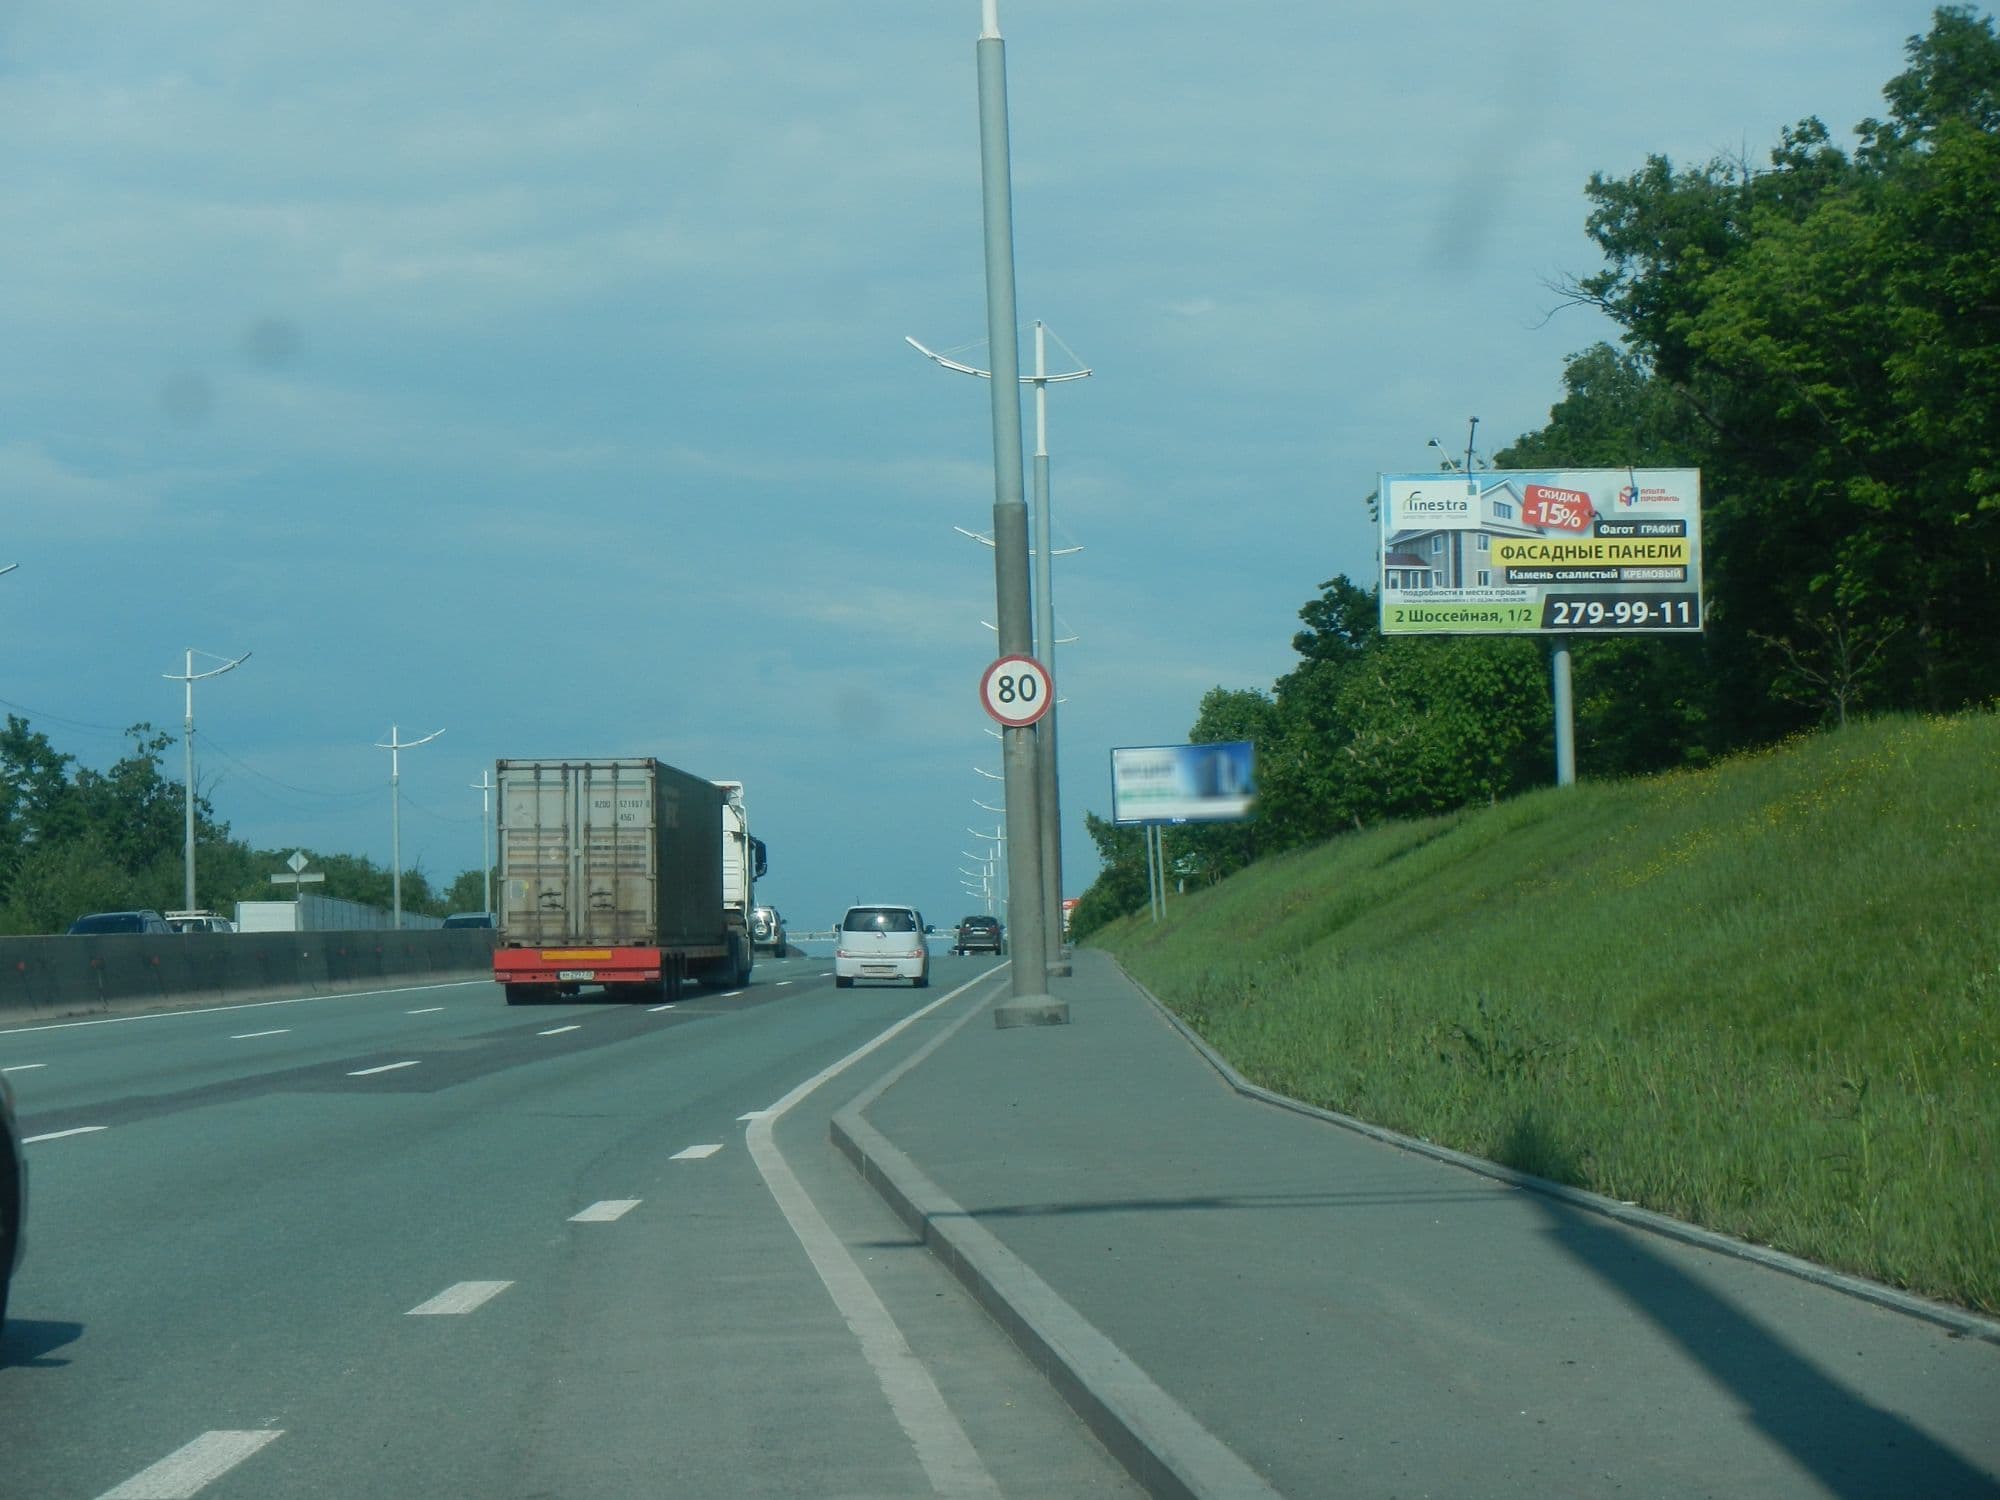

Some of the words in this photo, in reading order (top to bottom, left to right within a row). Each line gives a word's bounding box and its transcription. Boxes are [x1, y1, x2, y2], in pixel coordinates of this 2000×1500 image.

[1408, 491, 1467, 511] finestra
[1538, 488, 1581, 503] СКИДКА
[1527, 501, 1581, 528] -15%
[1600, 524, 1635, 535] Фагот
[1641, 524, 1681, 534] ГРАФИТ
[1500, 544, 1603, 561] ФАСАДНЫЕ
[1608, 544, 1682, 559] ПАНЕЛИ
[1509, 570, 1554, 580] Камень
[1556, 569, 1618, 580] скалистый
[1623, 568, 1681, 579] КРЕМОВЫЙ
[1395, 610, 1404, 623] 2
[1409, 609, 1503, 624] Шоссейная,
[1508, 609, 1533, 622] 1/2
[1553, 601, 1689, 624] 279-99-11
[999, 675, 1037, 703] 80
